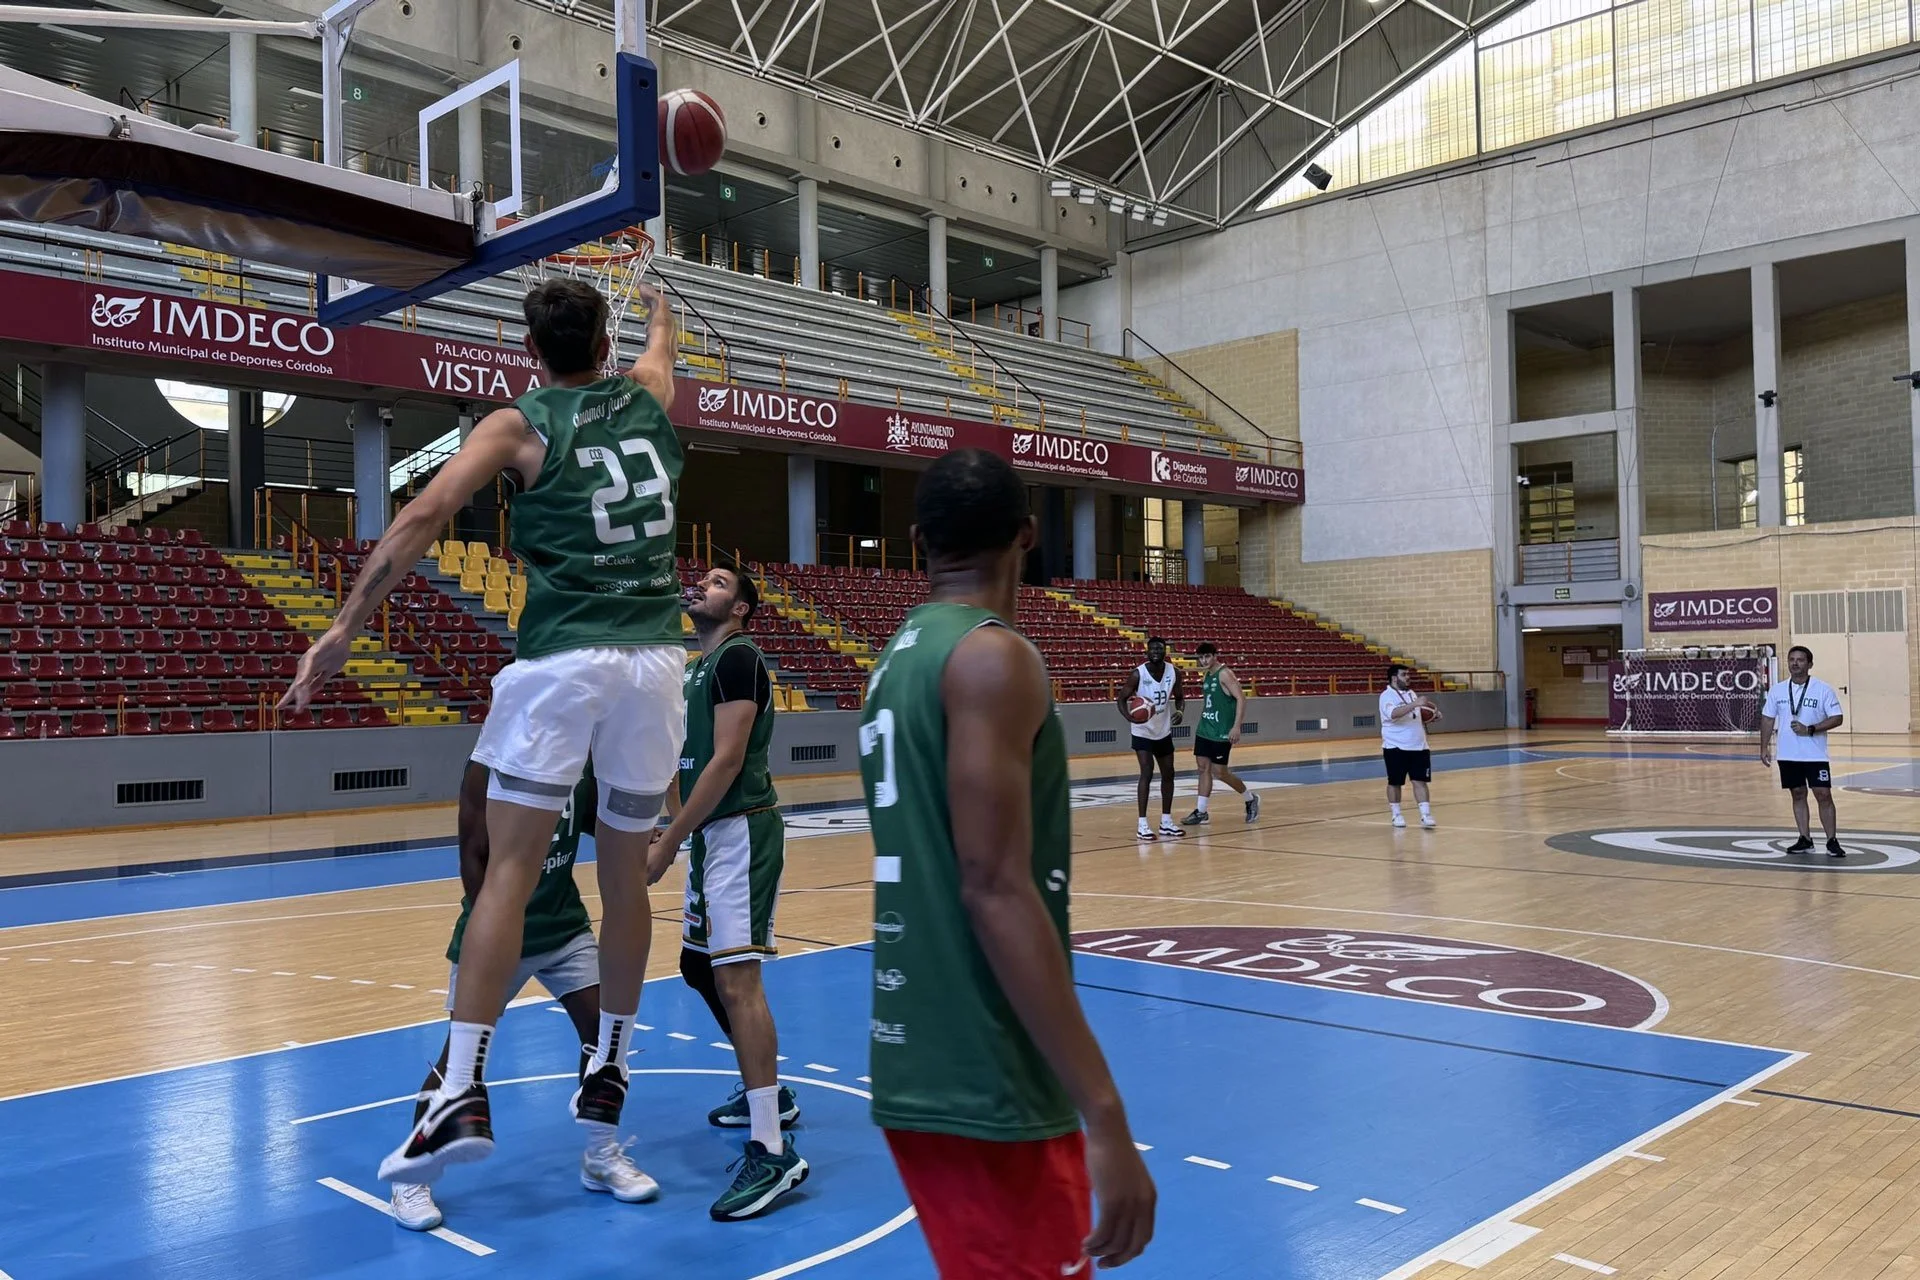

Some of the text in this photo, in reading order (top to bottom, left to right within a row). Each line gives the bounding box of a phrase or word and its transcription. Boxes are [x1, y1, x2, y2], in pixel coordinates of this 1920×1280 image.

[353, 87, 362, 101] 8
[724, 187, 732, 199] 9
[985, 257, 993, 267] 10
[152, 298, 335, 356] IMDECO
[92, 333, 334, 375] Instituto Municipal de Deportes Córdoba
[435, 342, 543, 370] PALACIO MUNICI
[420, 357, 513, 399] VISTA
[733, 389, 837, 429] IMDECO
[699, 416, 837, 442] Instituto Municipal de Deportes Córdoba
[910, 421, 955, 438] AYUNTAMIENTO
[911, 435, 949, 450] DE CÓRDOBA
[1036, 434, 1109, 465] IMDECO
[1172, 460, 1207, 474] Diputación
[1250, 466, 1299, 489] IMDECO
[1173, 473, 1208, 485] de Córdoba
[575, 438, 673, 544] 23
[1680, 596, 1773, 617] IMDECO
[1645, 670, 1758, 692] IMDECO
[1154, 690, 1167, 705] 33
[1803, 697, 1818, 709] CCB
[1088, 934, 1607, 1012] IMDECO
